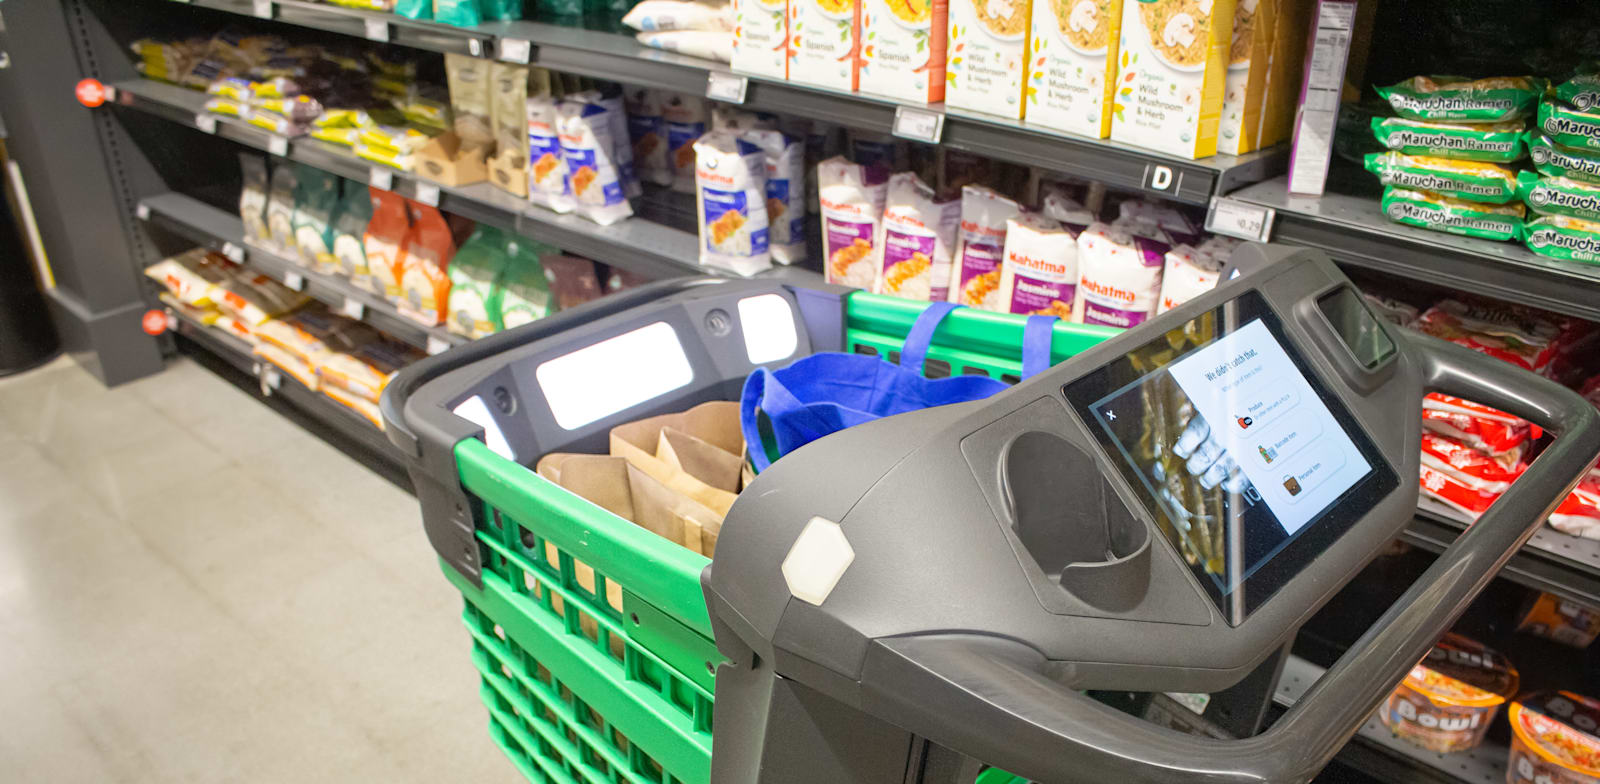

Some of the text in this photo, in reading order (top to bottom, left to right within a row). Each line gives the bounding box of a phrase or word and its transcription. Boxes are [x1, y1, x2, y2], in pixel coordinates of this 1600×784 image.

[968, 53, 985, 64] Wild
[968, 64, 1007, 77] Mushroom
[1050, 68, 1066, 79] Wild
[1050, 79, 1089, 94] Mushroom
[1139, 83, 1158, 96] Wild
[1055, 91, 1073, 102] Herb
[1138, 95, 1183, 112] Mushroom
[1465, 98, 1512, 109] Ramen
[1137, 106, 1165, 121] & Herb
[1401, 133, 1463, 148] Maruchan
[1151, 165, 1173, 191] D
[1392, 173, 1502, 195] Maruchan Ramen
[1402, 204, 1462, 225] Maruchan
[1465, 217, 1513, 233] Ramen
[1009, 251, 1066, 275] Mahatma
[1016, 279, 1060, 299] Jasmine
[1081, 275, 1136, 302] Mahatma
[1086, 306, 1130, 327] Jasmine
[1205, 372, 1217, 381] We
[1398, 698, 1481, 732] Bowl
